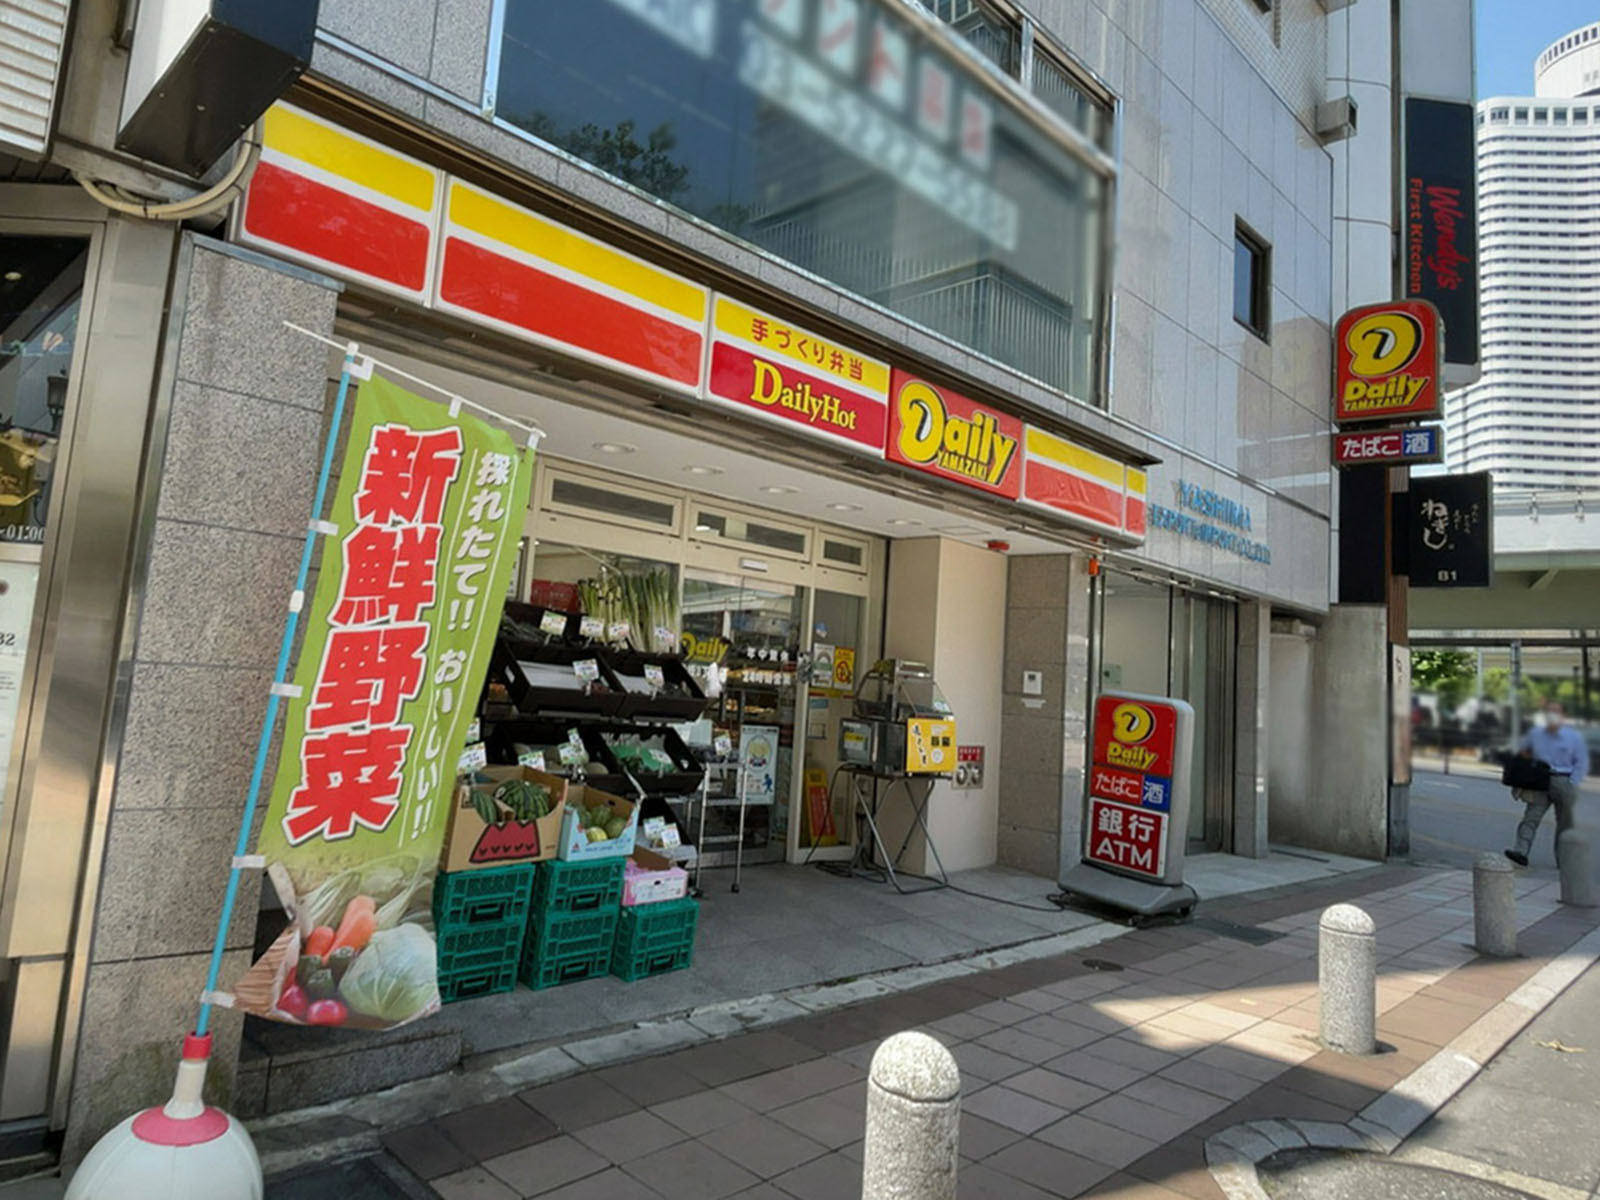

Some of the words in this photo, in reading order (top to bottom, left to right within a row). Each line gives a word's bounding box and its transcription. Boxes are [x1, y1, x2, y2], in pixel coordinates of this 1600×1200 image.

[1426, 186, 1469, 289] Wendy's
[751, 318, 863, 381] 手づくり弁当
[750, 359, 856, 430] DailyHot
[1344, 374, 1430, 406] Daily
[899, 380, 1018, 486] Daily
[1342, 435, 1400, 458] たばこ
[1405, 432, 1430, 454] 酒
[282, 423, 463, 847] 新鮮野菜
[1107, 741, 1159, 770] Daily
[1095, 771, 1140, 800] たばこ
[1143, 780, 1165, 805] 酒
[1097, 806, 1155, 843] 銀行
[1096, 836, 1153, 870] ATM
